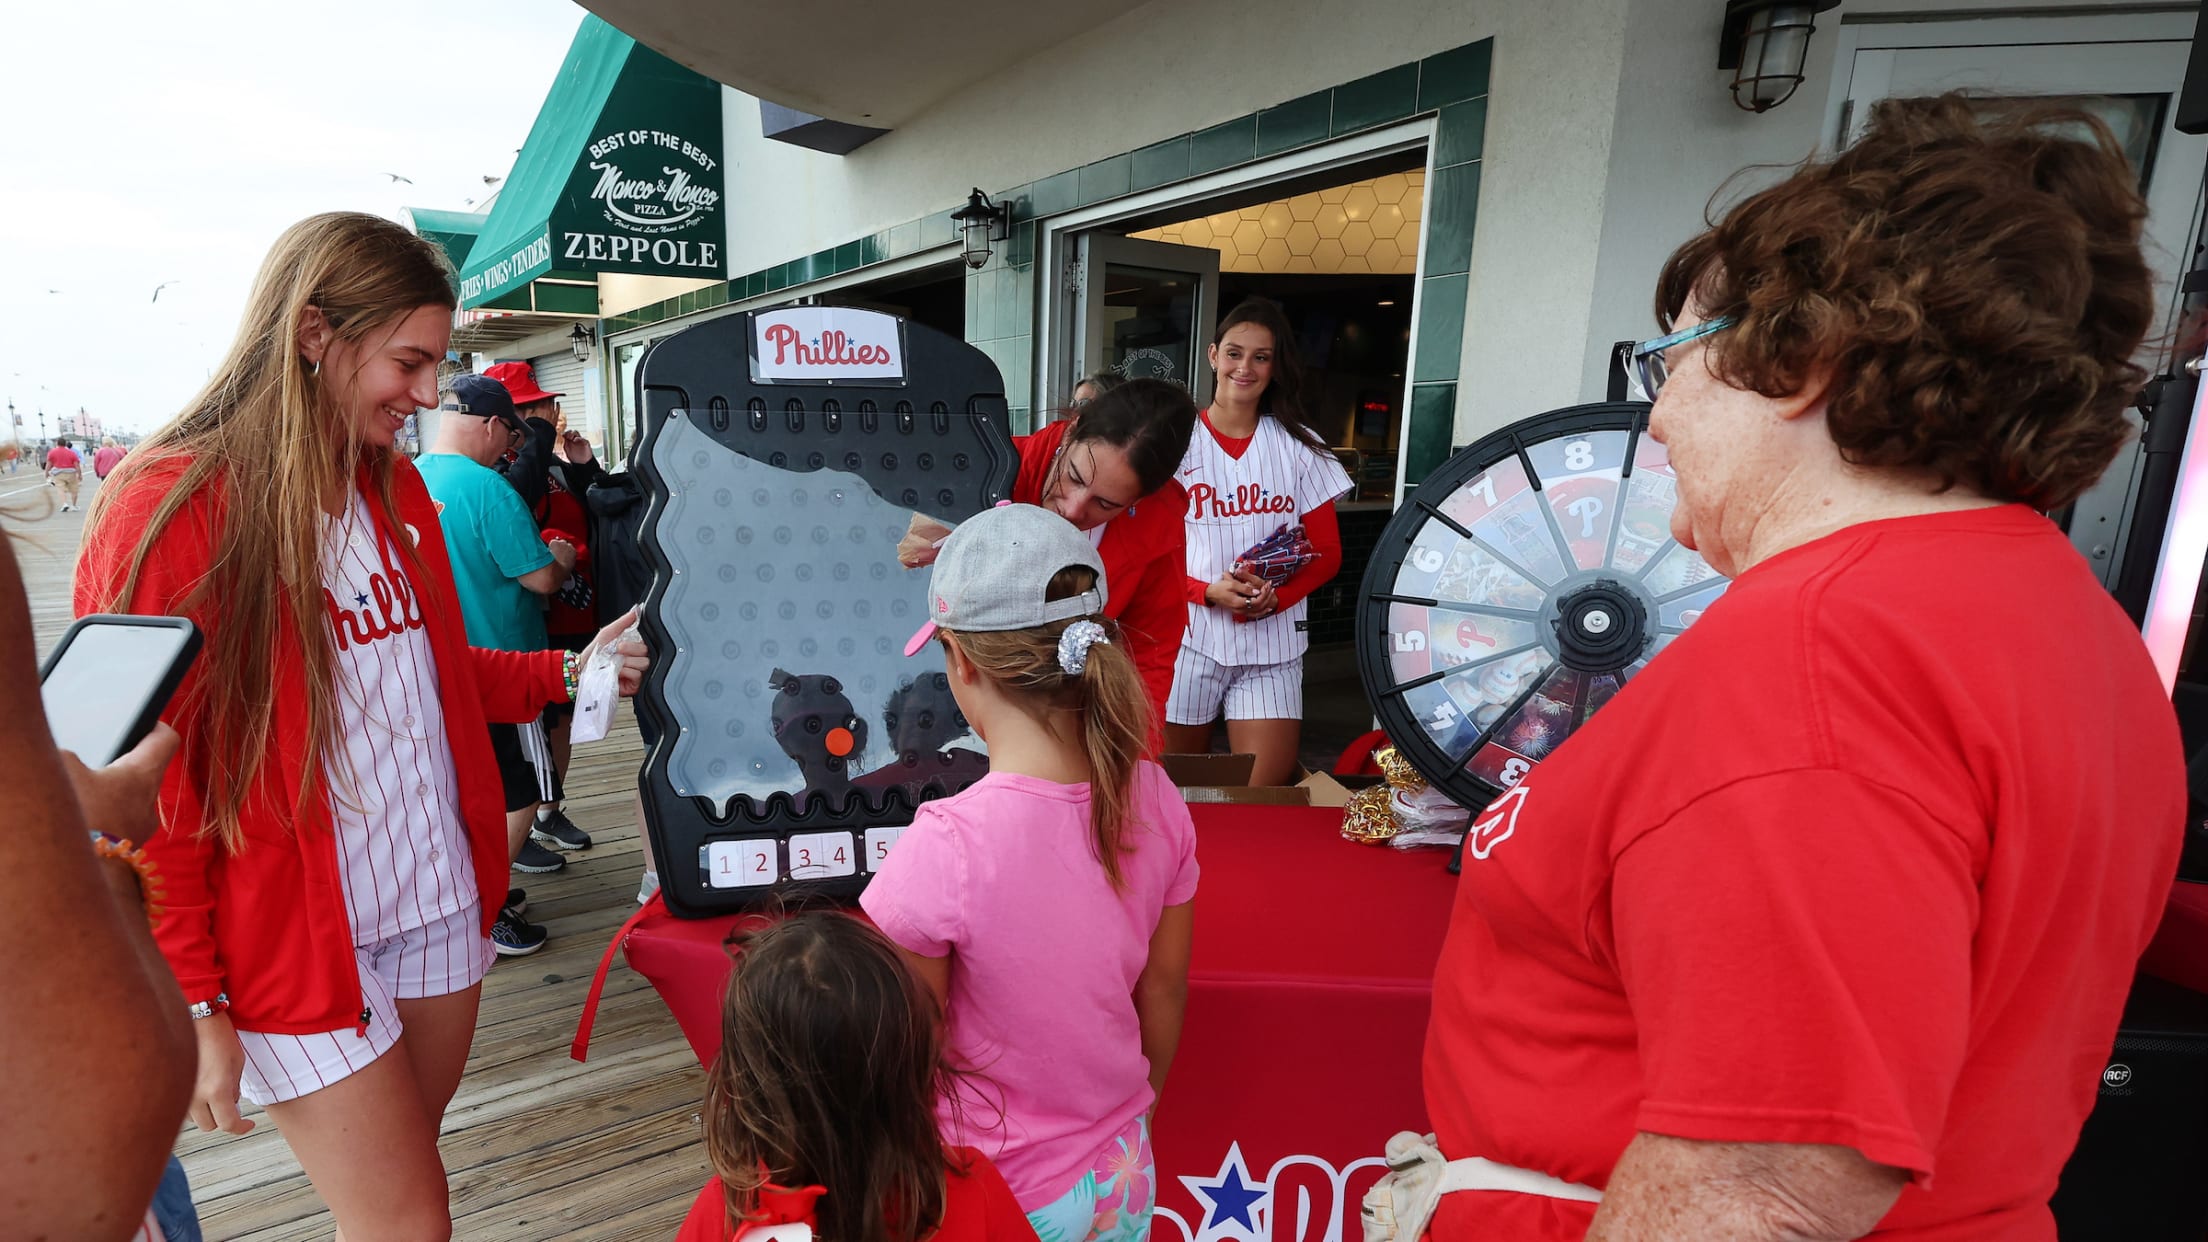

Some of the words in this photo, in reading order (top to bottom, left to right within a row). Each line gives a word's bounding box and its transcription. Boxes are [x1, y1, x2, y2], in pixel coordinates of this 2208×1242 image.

[589, 132, 625, 159] BEST
[628, 130, 649, 145] OF
[651, 131, 680, 150] THE
[682, 141, 717, 172] BEST
[589, 161, 657, 200] Manco
[656, 179, 668, 193] &
[662, 166, 720, 208] Manco
[634, 203, 667, 216] PIZZA
[614, 219, 630, 230] First
[630, 225, 643, 233] and
[643, 226, 660, 234] Last
[484, 259, 509, 292] WINGS
[511, 232, 551, 278] TENDERS
[564, 232, 718, 268] ZEPPOLE
[764, 323, 890, 365] Phillies
[1564, 440, 1595, 471] 8
[1187, 483, 1295, 520] Phillies
[1469, 475, 1499, 508] 7
[1413, 546, 1444, 573] 6
[322, 569, 424, 652] hill
[1395, 629, 1427, 654] 5
[1429, 701, 1459, 732] 4
[1499, 757, 1532, 788] 3
[719, 856, 732, 874] 1
[755, 853, 768, 872] 2
[799, 849, 811, 867] 3
[833, 846, 847, 864] 4
[876, 841, 888, 860] 5
[2106, 1070, 2129, 1081] RCF
